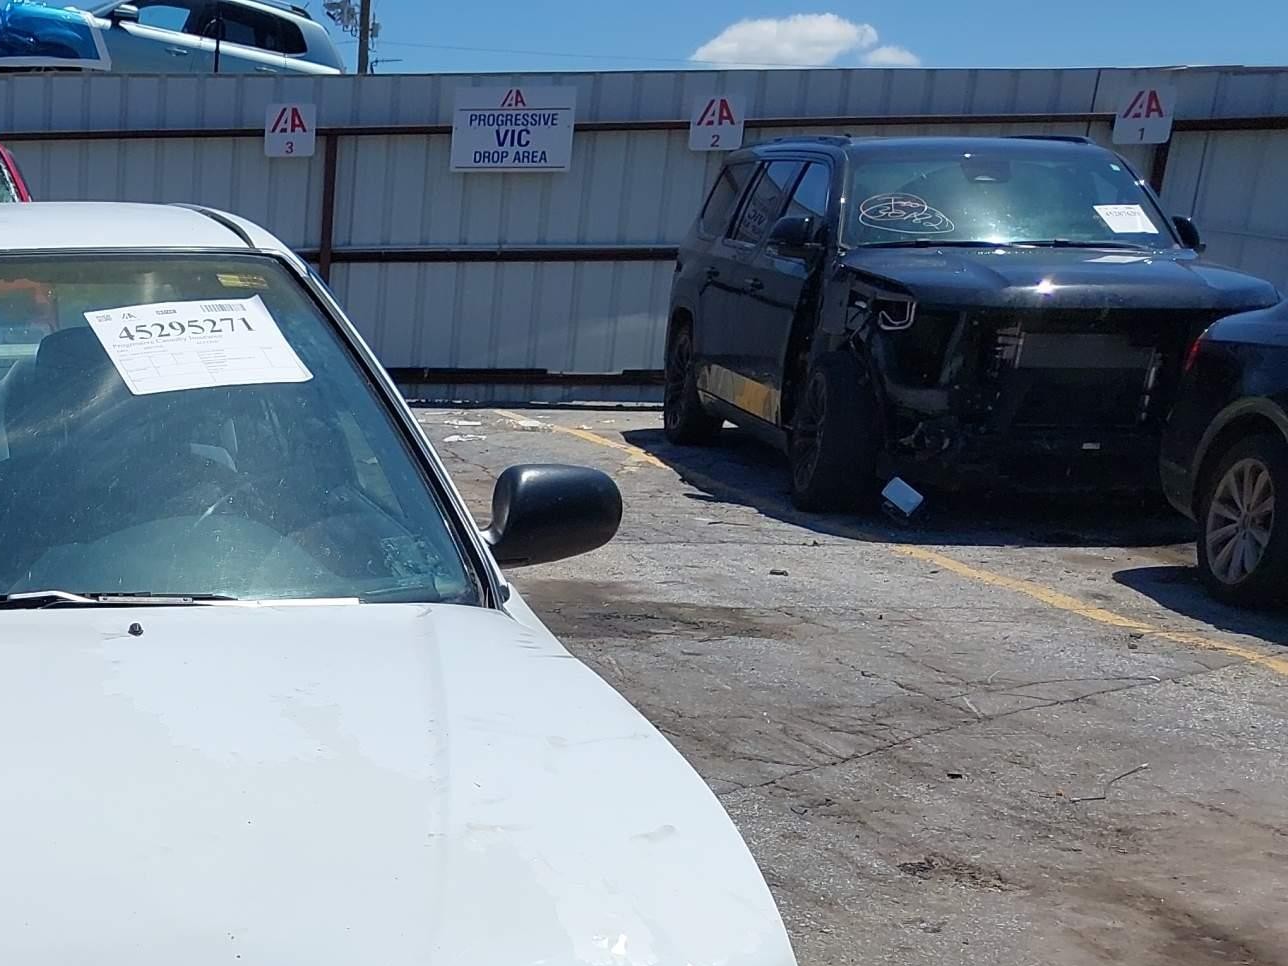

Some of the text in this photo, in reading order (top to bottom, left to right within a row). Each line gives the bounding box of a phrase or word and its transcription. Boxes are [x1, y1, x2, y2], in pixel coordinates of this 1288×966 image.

[469, 113, 560, 127] PROGRESSIVE
[495, 128, 531, 147] VIC
[1138, 127, 1145, 140] 1
[710, 134, 720, 147] 2
[285, 141, 294, 154] 3
[473, 151, 548, 164] DROP AREA
[118, 317, 257, 342] 45295271
